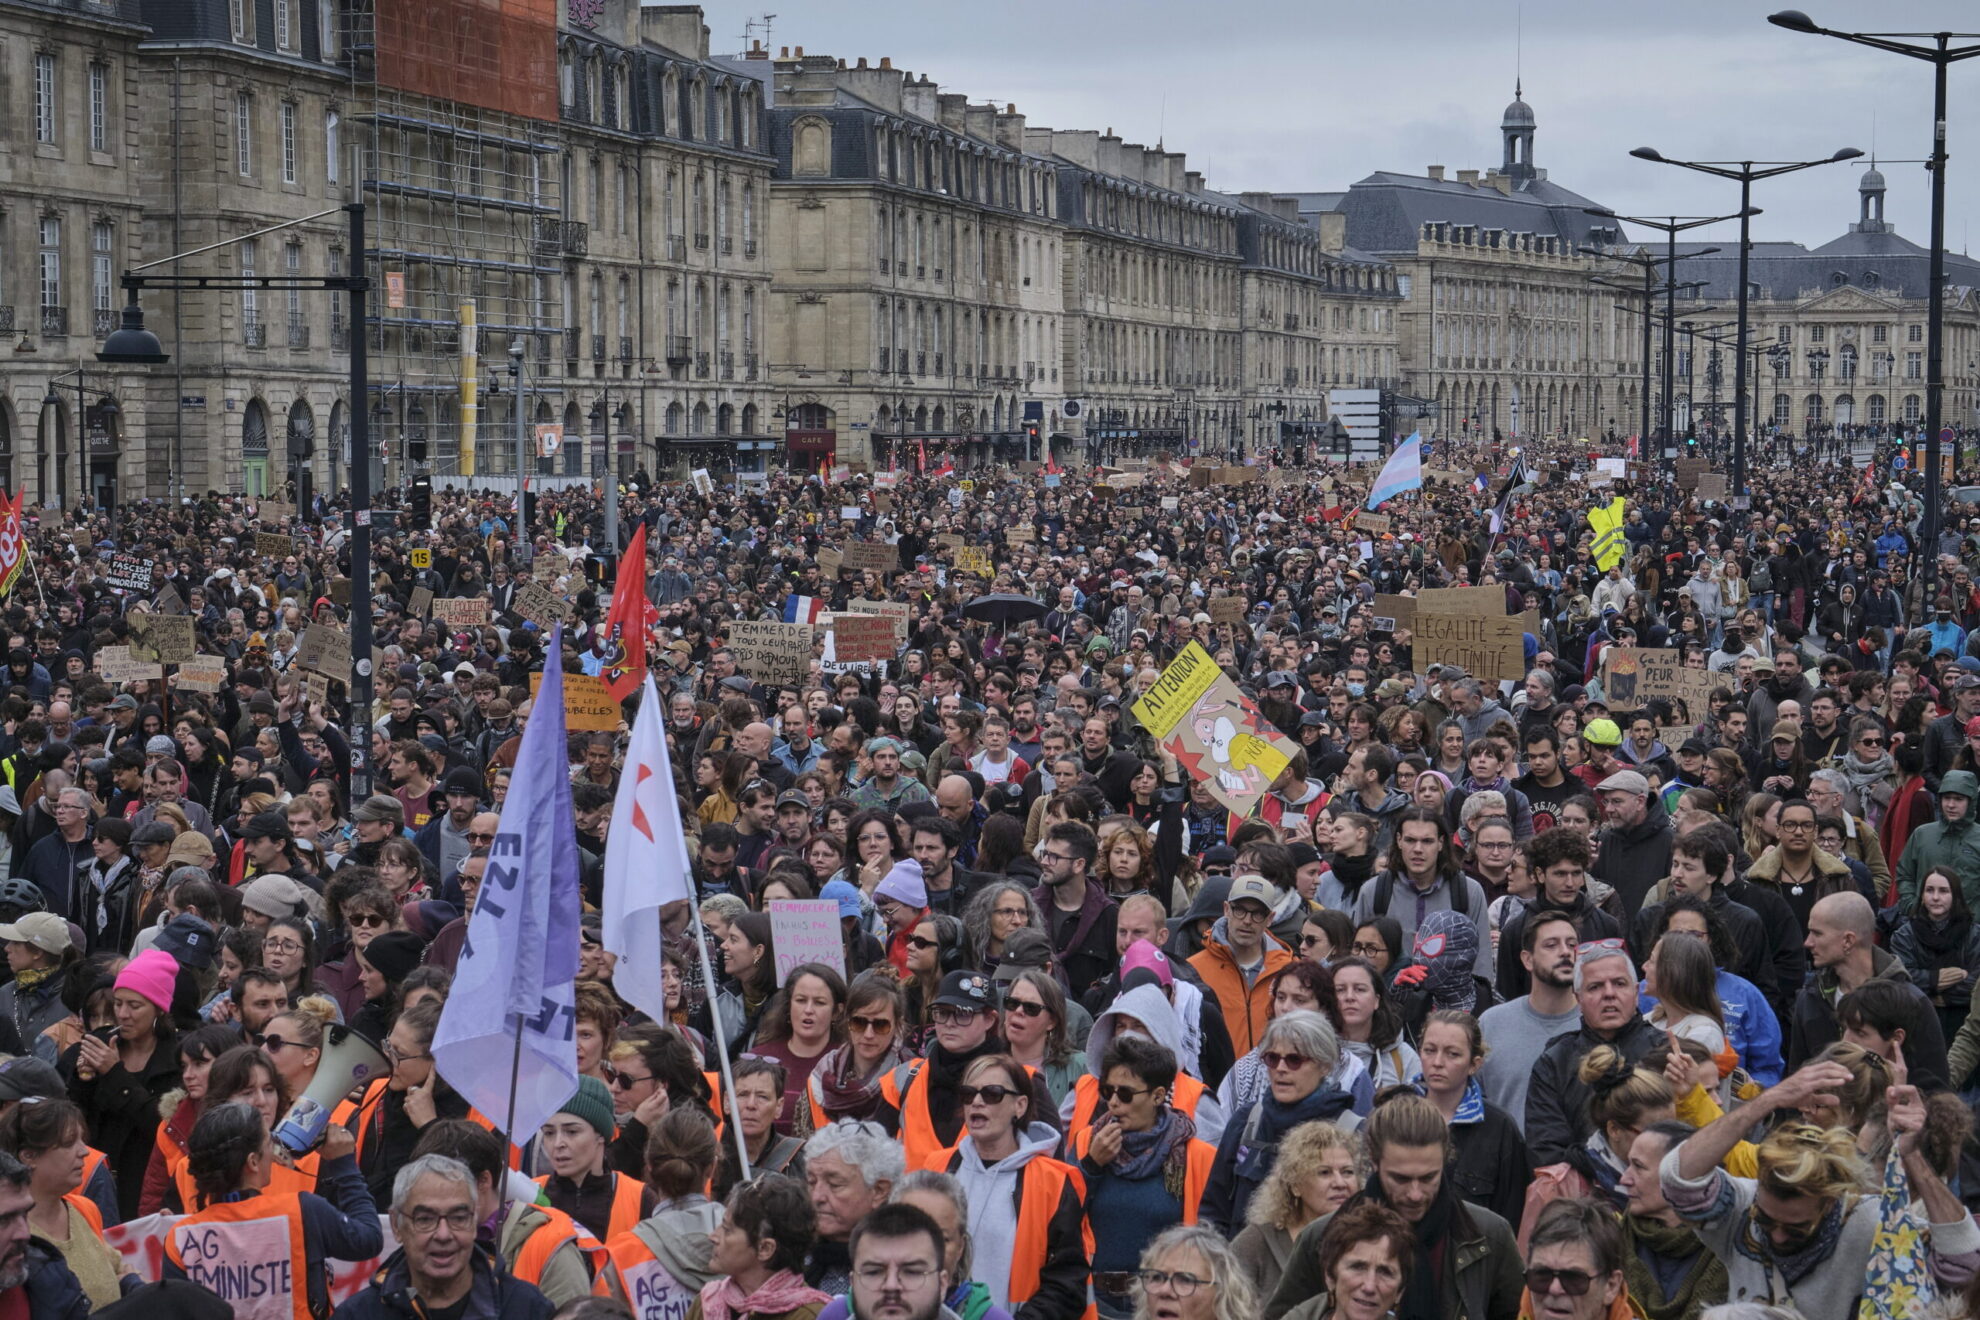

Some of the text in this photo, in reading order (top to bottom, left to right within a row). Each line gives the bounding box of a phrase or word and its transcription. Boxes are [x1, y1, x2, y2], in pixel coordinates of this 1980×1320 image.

[962, 483, 972, 491] 25
[143, 558, 154, 567] TO
[415, 553, 428, 563] 15
[112, 561, 152, 575] FASCISM
[105, 577, 151, 591] MINORITIES
[131, 572, 151, 583] FOR
[525, 591, 545, 607] PIG
[862, 606, 880, 616] NOUS
[735, 637, 758, 646] TOUS
[823, 660, 837, 671] DE
[1646, 668, 1674, 682] PEUR
[1698, 671, 1728, 689] SUIS
[1143, 649, 1201, 718] ATTENTION
[563, 706, 614, 717] OUBELLES
[181, 1229, 220, 1260] AG
[184, 1258, 292, 1301] ÉMINISTE
[636, 1272, 671, 1307] AG
